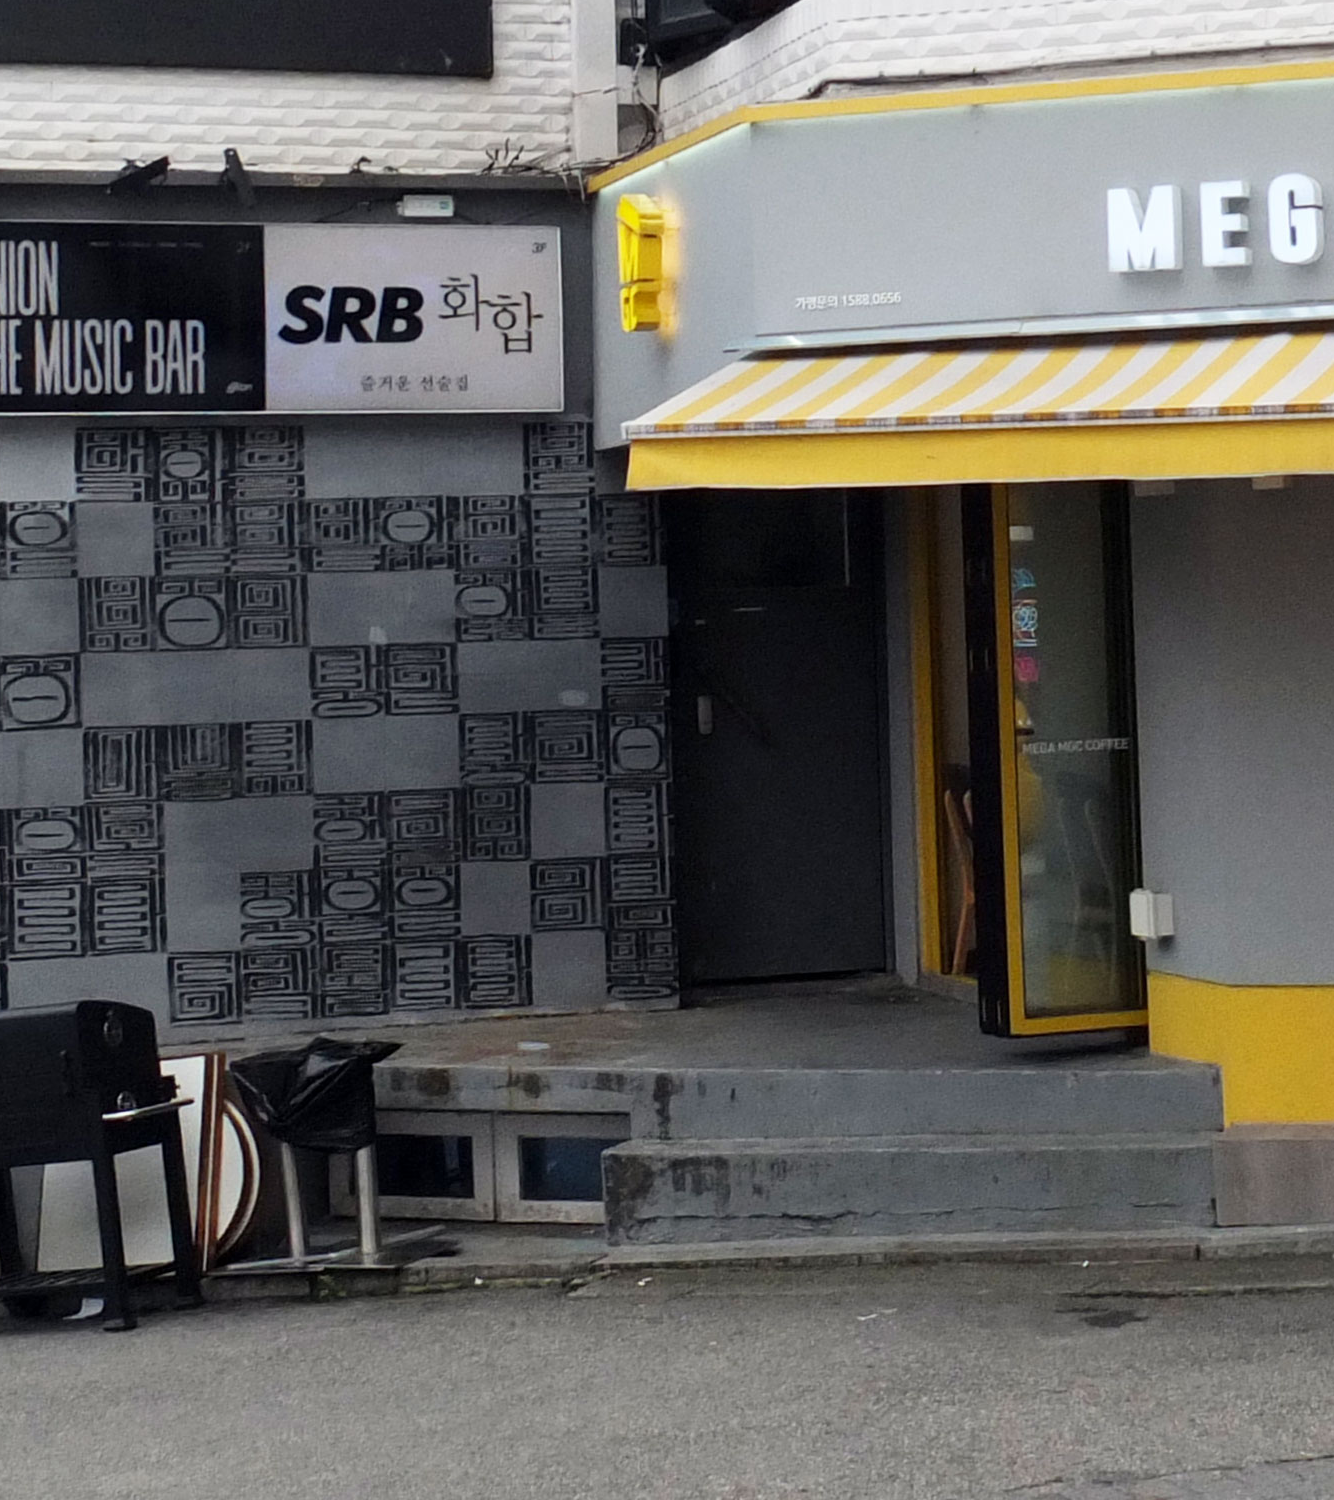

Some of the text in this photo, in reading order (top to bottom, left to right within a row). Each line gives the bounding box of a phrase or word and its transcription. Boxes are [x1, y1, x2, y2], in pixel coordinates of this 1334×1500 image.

[278, 273, 544, 355] SRB 화합
[34, 318, 133, 395] MUSIC
[145, 319, 206, 395] BAR
[360, 375, 411, 392] 즐거운
